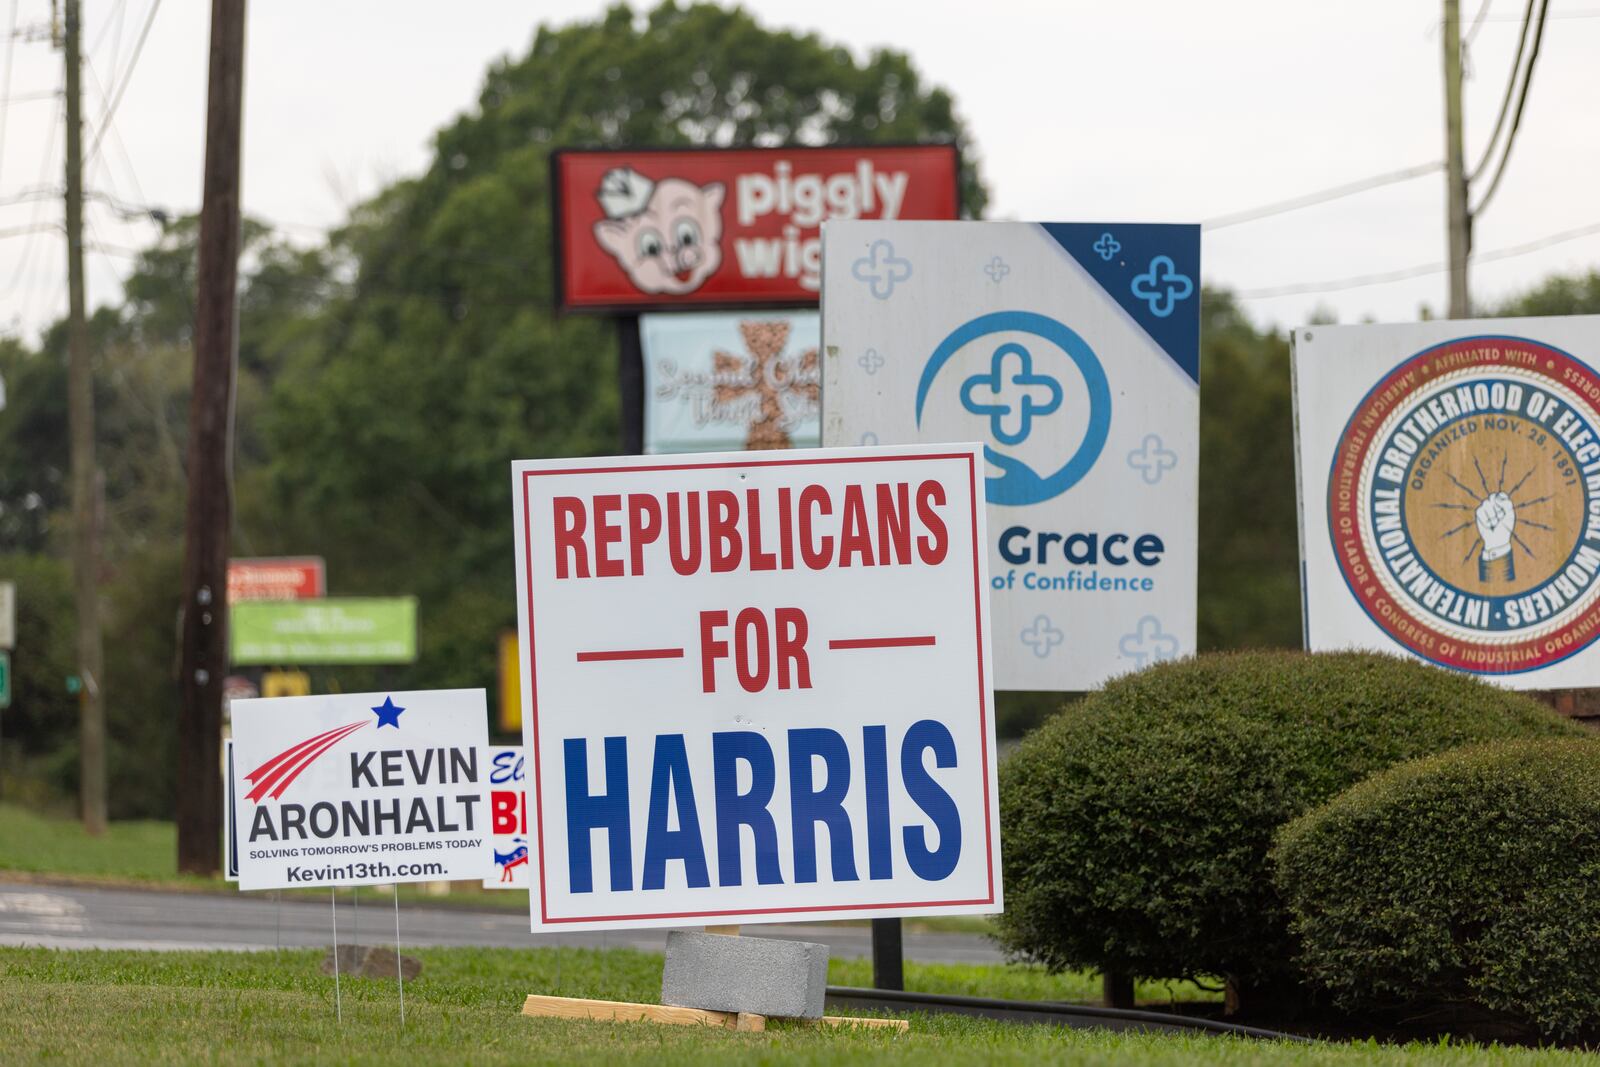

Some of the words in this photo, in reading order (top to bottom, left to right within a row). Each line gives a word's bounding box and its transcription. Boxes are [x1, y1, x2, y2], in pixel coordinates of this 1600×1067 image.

[736, 160, 909, 228] piggly
[1435, 349, 1500, 371] AFFILIATED
[1505, 349, 1537, 365] WITH
[1361, 371, 1415, 429] AMERICAN
[1526, 391, 1559, 423] OF
[1378, 382, 1523, 483] BROTHERHOOD
[1411, 421, 1477, 490] ORGANIZED
[1484, 418, 1521, 434] NOV.
[1551, 450, 1577, 487] 1891
[1339, 429, 1367, 512] FEDERATION
[553, 479, 948, 579] REPUBLICANS
[998, 525, 1165, 566] Grace
[1340, 517, 1353, 536] OF
[991, 569, 1016, 590] of
[1023, 570, 1154, 592] Confidence
[1344, 539, 1369, 585] LABOR
[1374, 488, 1490, 627] INTERNATIONAL
[1504, 544, 1600, 627] WORKERS
[1375, 598, 1436, 649] CONGRESS
[700, 607, 813, 693] FOR
[1439, 643, 1458, 657] OF
[1461, 647, 1542, 664] INDUSTRIAL
[351, 747, 478, 788] KEVIN
[249, 795, 481, 842] ARONHALT
[563, 719, 962, 894] HARRIS
[250, 848, 299, 859] SOLVING
[300, 843, 379, 856] TOMORROW'S
[381, 840, 443, 852] PROBLEMS
[444, 839, 482, 850] TODAY
[287, 862, 448, 882] Kevin13th.com.
